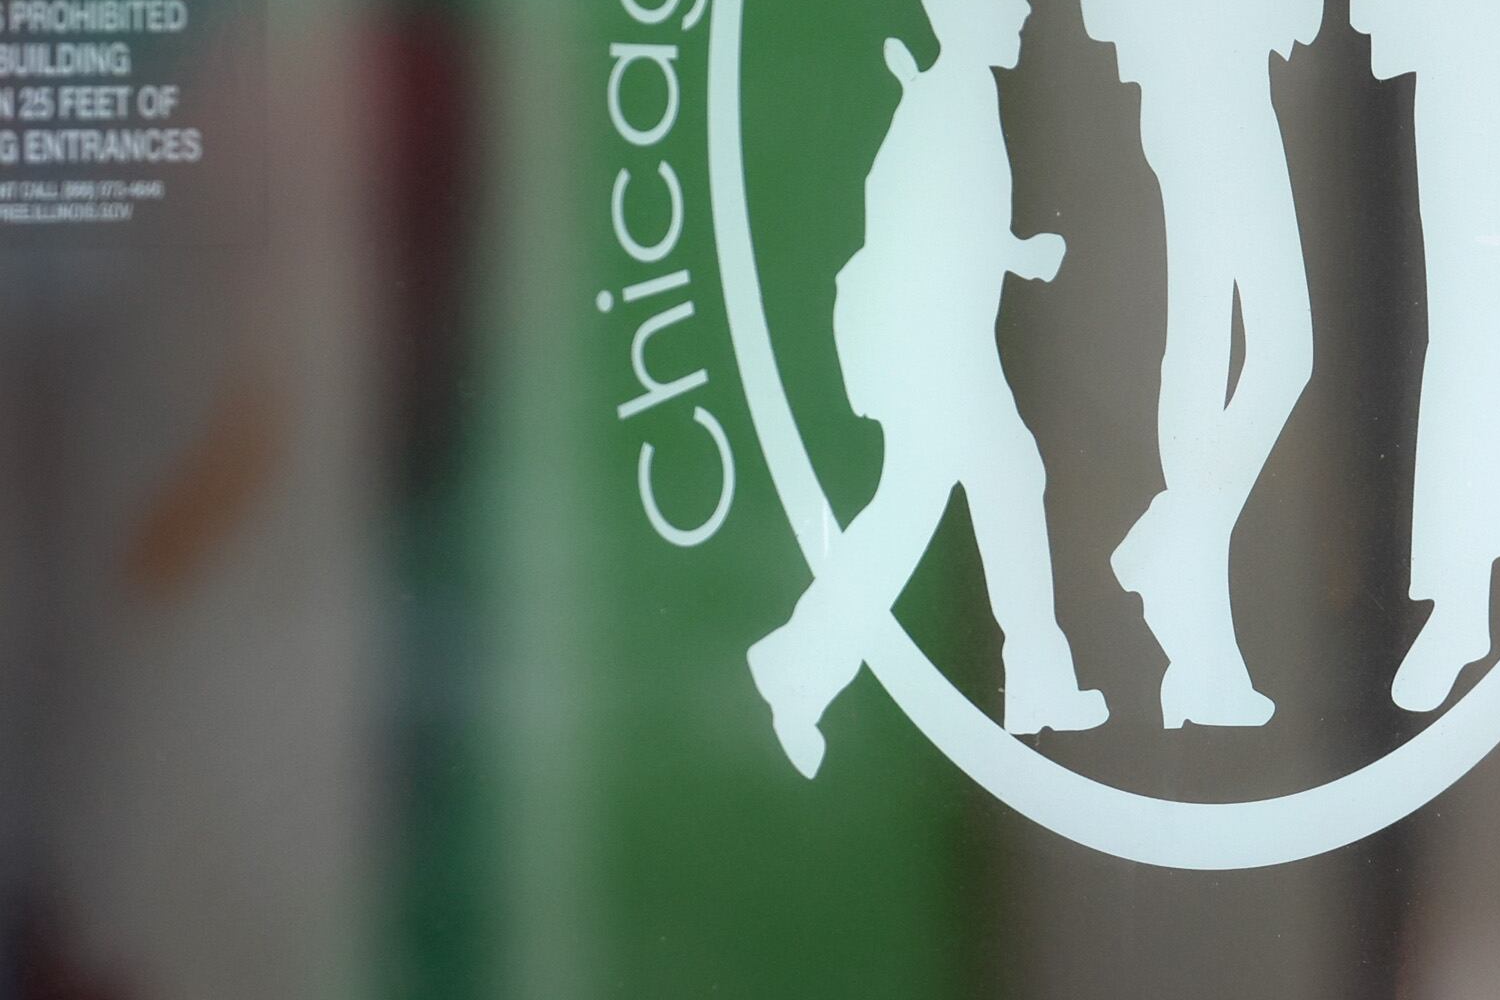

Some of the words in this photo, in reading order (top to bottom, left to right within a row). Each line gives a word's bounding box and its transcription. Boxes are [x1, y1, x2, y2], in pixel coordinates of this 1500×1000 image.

[18, 86, 54, 120] 25
[58, 85, 131, 120] FEET
[136, 84, 179, 119] OF
[23, 128, 202, 163] ENTRANCES
